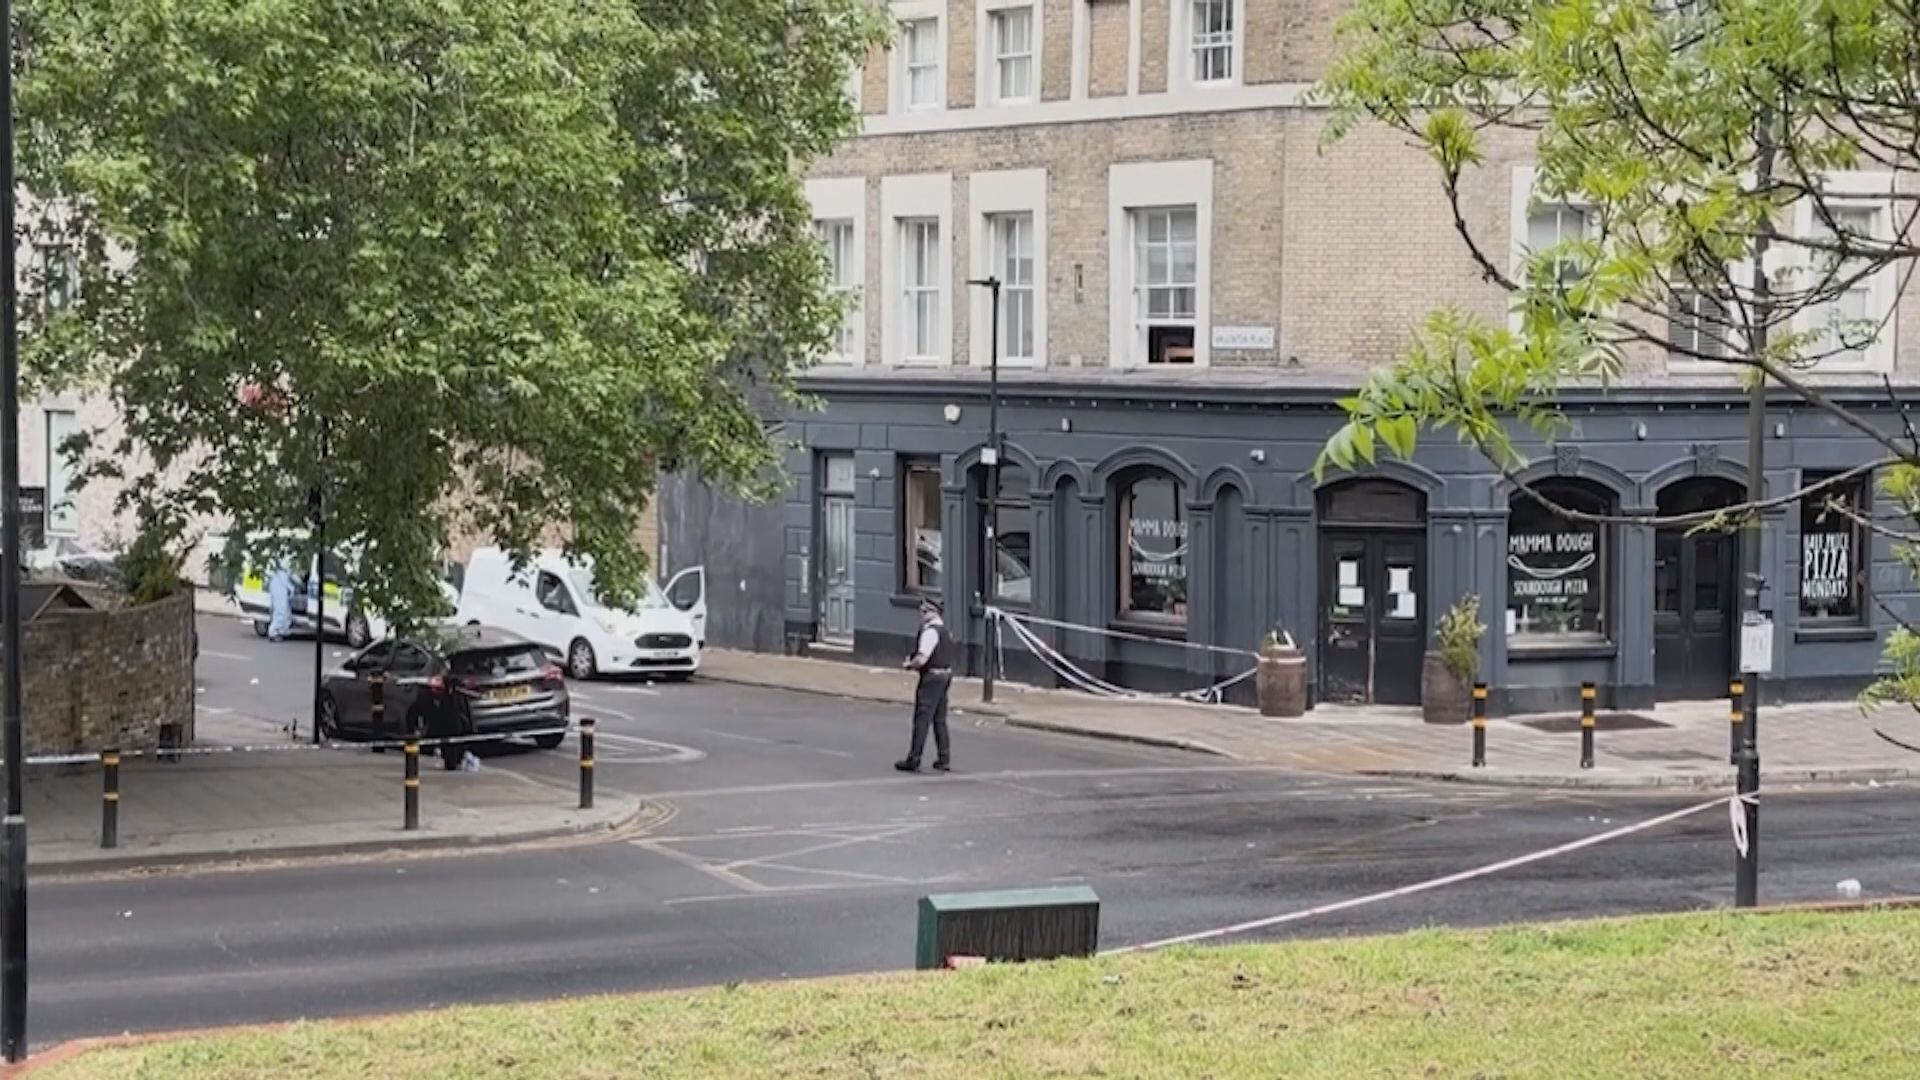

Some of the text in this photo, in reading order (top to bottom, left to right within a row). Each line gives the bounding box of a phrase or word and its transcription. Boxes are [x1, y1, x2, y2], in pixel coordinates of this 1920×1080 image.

[1510, 532, 1594, 554] MAMMA DOUGH
[1804, 549, 1848, 579] PIZZA
[1514, 579, 1588, 595] SOURDOUGH PIZZA
[1803, 579, 1848, 598] MONDAYS
